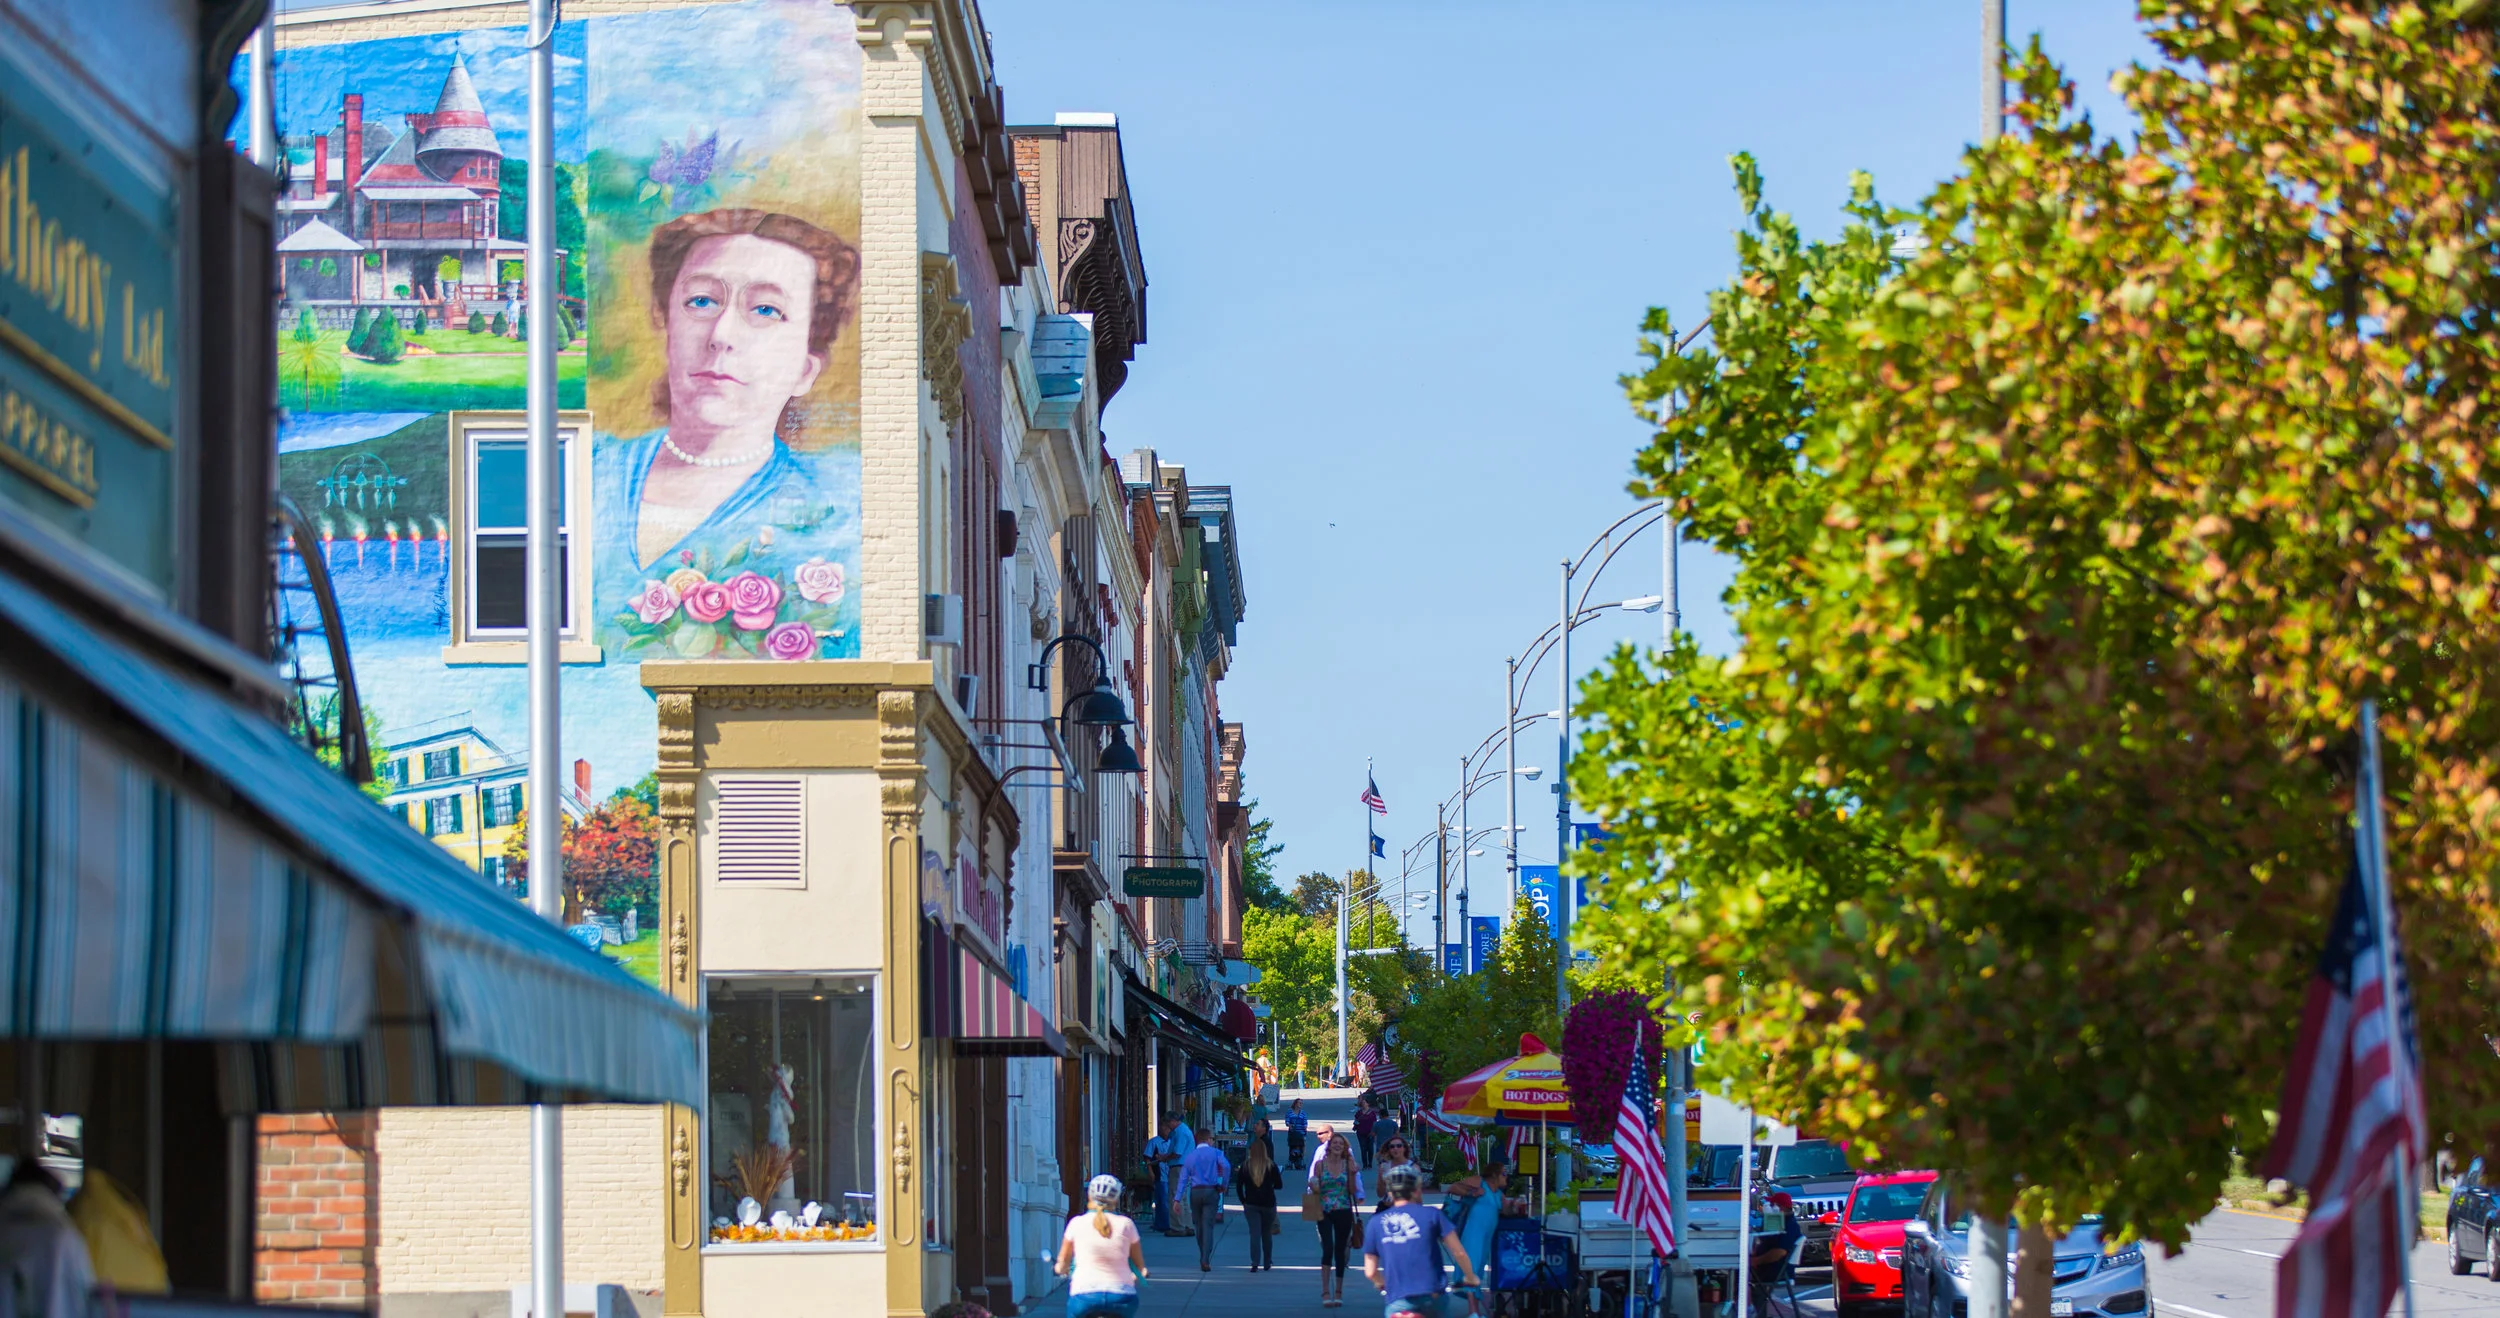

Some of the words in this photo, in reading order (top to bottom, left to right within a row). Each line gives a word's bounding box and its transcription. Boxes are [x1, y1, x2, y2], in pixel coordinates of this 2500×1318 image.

[1132, 877, 1197, 887] PHOTOGRAPHY
[1531, 887, 1550, 927] OP
[1505, 1091, 1530, 1101] HOT
[1532, 1091, 1565, 1102] DOGS
